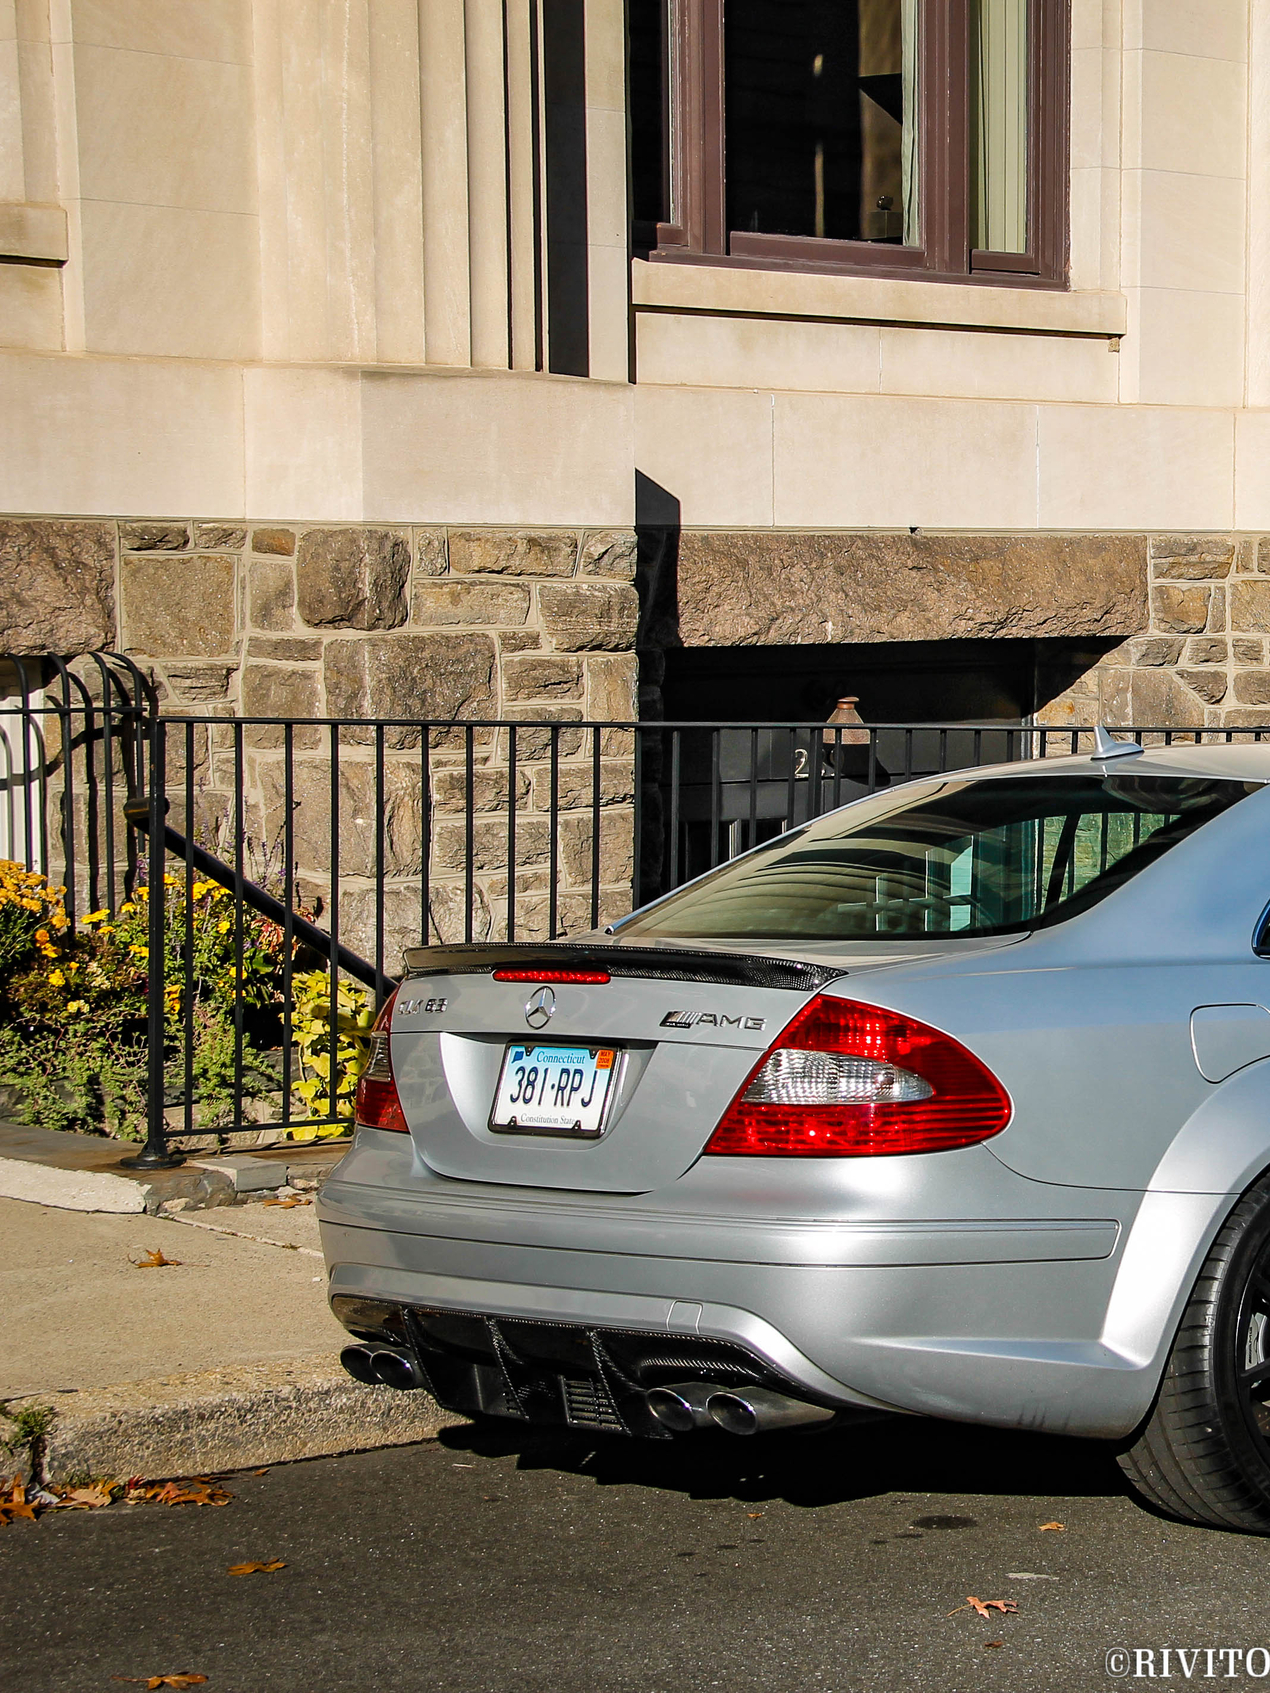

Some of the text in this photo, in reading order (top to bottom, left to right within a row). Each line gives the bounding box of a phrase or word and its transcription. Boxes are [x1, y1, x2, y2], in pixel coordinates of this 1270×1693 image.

[696, 1013, 767, 1031] AMG
[536, 1051, 586, 1064] Connecticut
[520, 1112, 575, 1125] Constitution State
